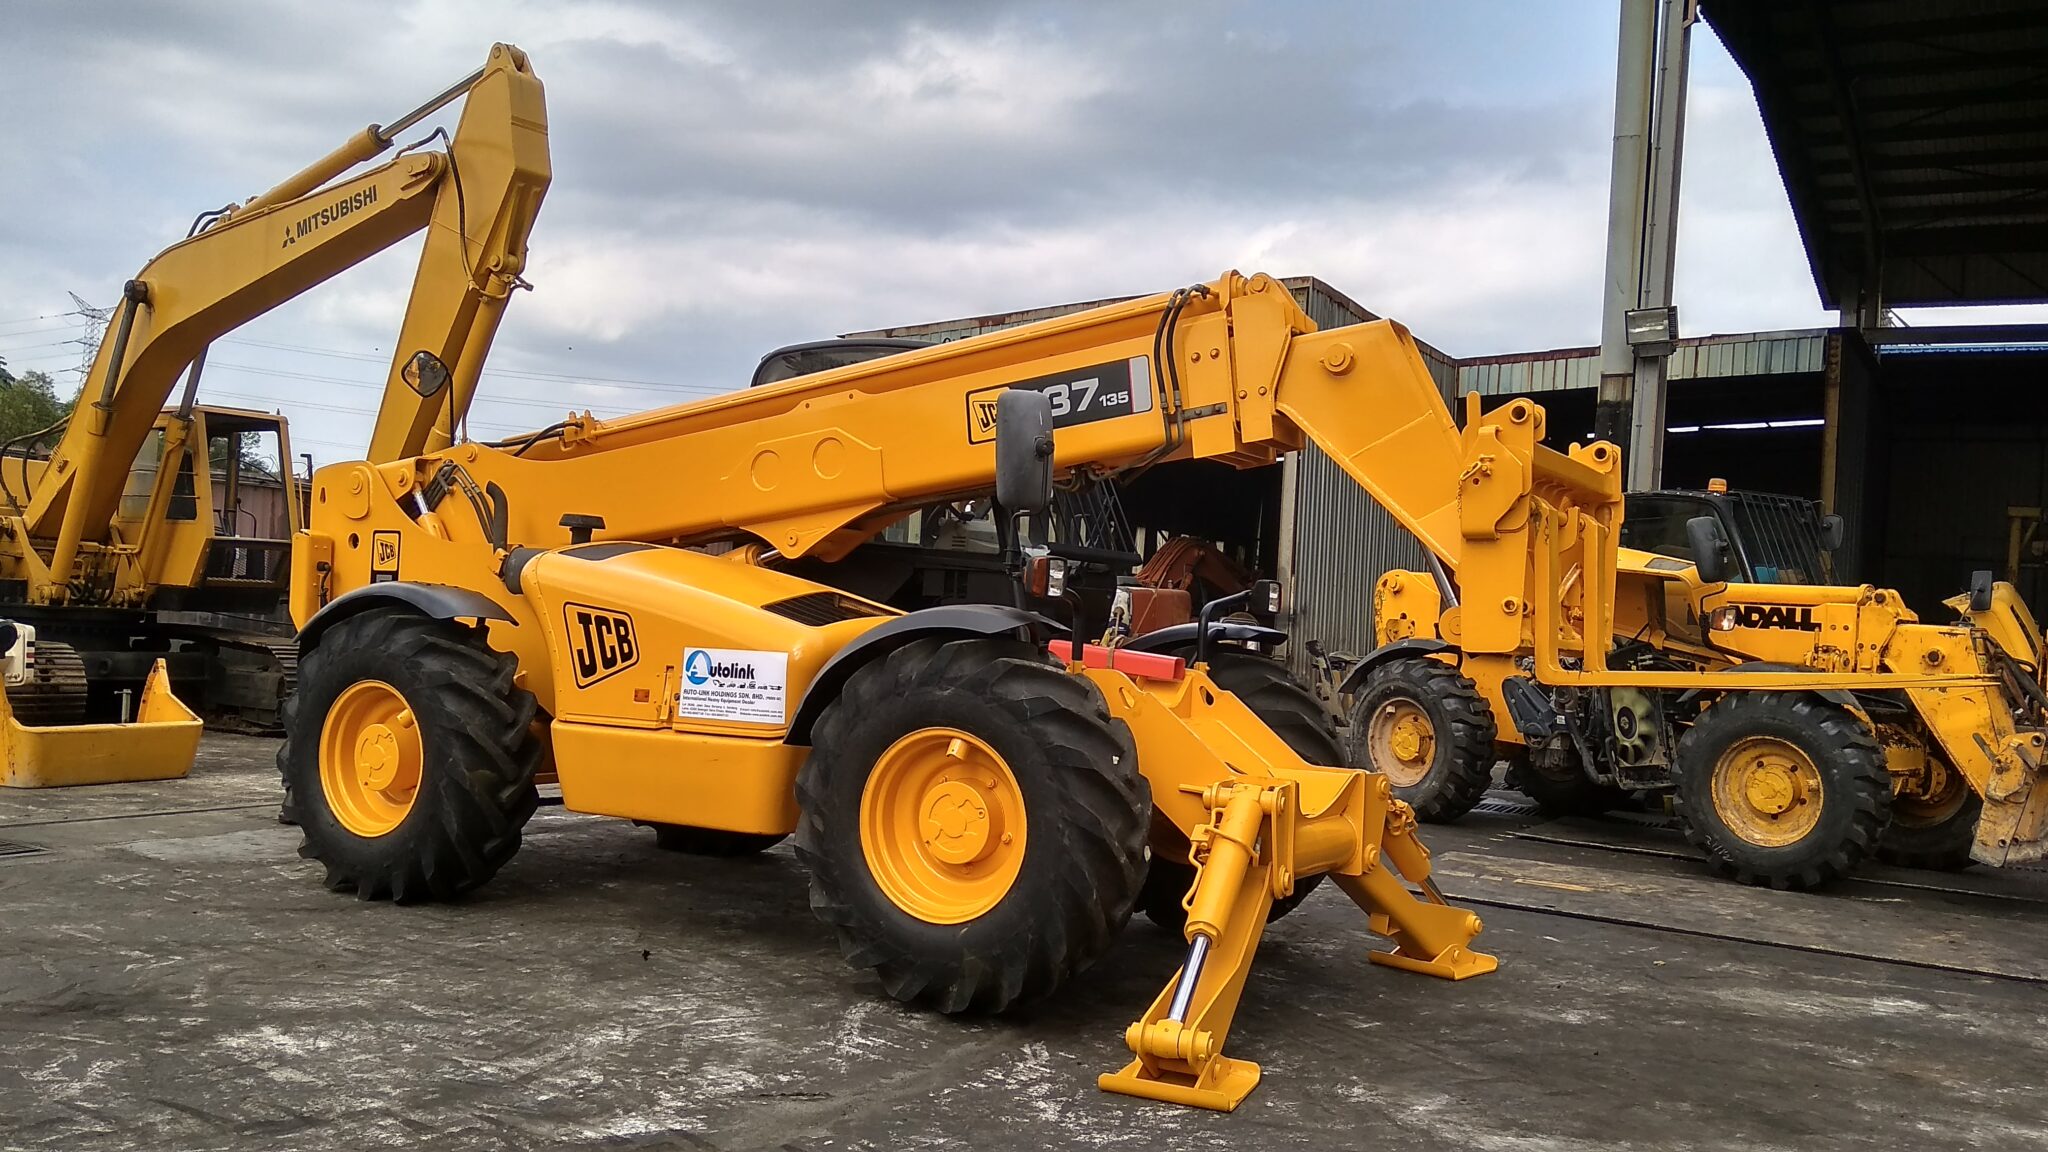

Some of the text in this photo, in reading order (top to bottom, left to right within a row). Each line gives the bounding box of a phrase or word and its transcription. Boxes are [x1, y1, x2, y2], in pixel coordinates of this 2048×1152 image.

[296, 184, 378, 238] MITSUBISHI
[1035, 377, 1129, 417] 37 135
[978, 403, 998, 429] JC
[379, 541, 395, 562] JCB
[576, 611, 634, 679] JCB
[685, 650, 755, 685] Autolink
[683, 688, 710, 696] AUTO-LINK
[711, 690, 737, 698] HOLDINGS
